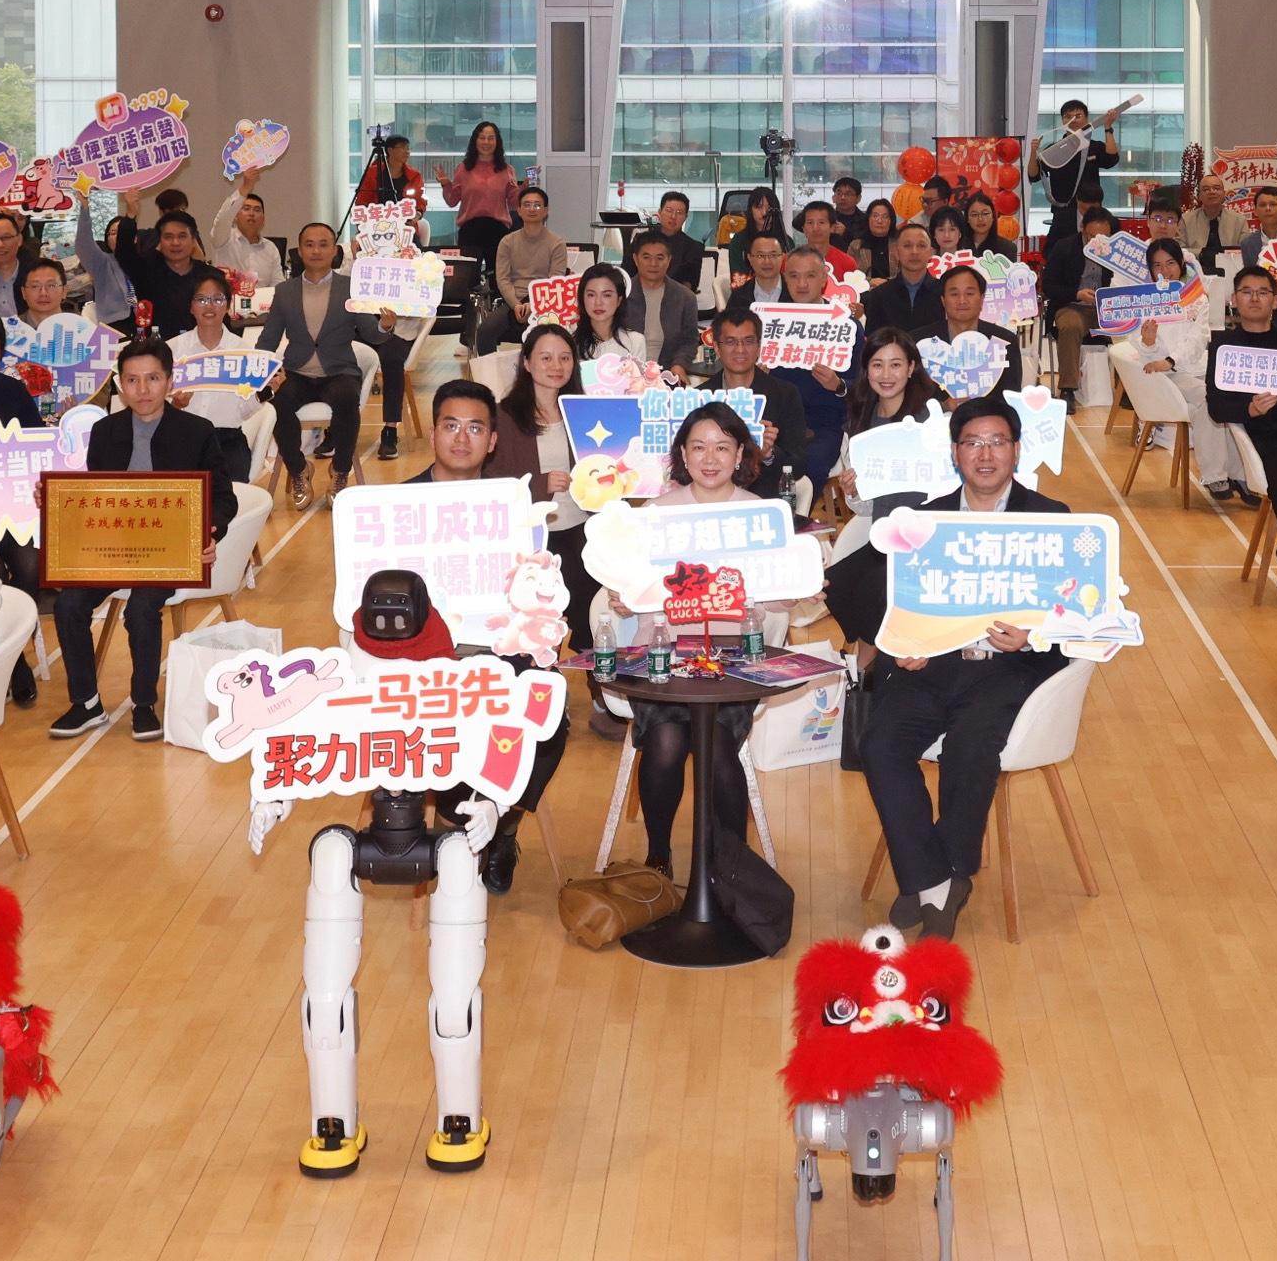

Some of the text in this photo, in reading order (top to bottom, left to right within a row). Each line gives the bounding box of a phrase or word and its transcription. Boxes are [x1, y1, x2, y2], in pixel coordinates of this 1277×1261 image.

[65, 119, 175, 167] 造梗整活点赞
[98, 137, 190, 181] 正能量加码
[352, 200, 415, 223] 马年大吉
[359, 265, 416, 282] 键下开花
[763, 318, 852, 343] 乘风破浪
[760, 340, 849, 368] 勇敢前行
[63, 496, 188, 509] 广东省网络文明素养
[84, 516, 164, 530] 实践教育基地
[352, 499, 510, 547] 马到成功
[944, 531, 1065, 568] 心有所悦
[919, 568, 1040, 606] 业有所长
[665, 598, 699, 610] GOOD
[670, 608, 703, 619] LUCK
[266, 697, 292, 714] HAPPY
[326, 667, 511, 721] 一马当先
[263, 726, 460, 790] 聚力同行
